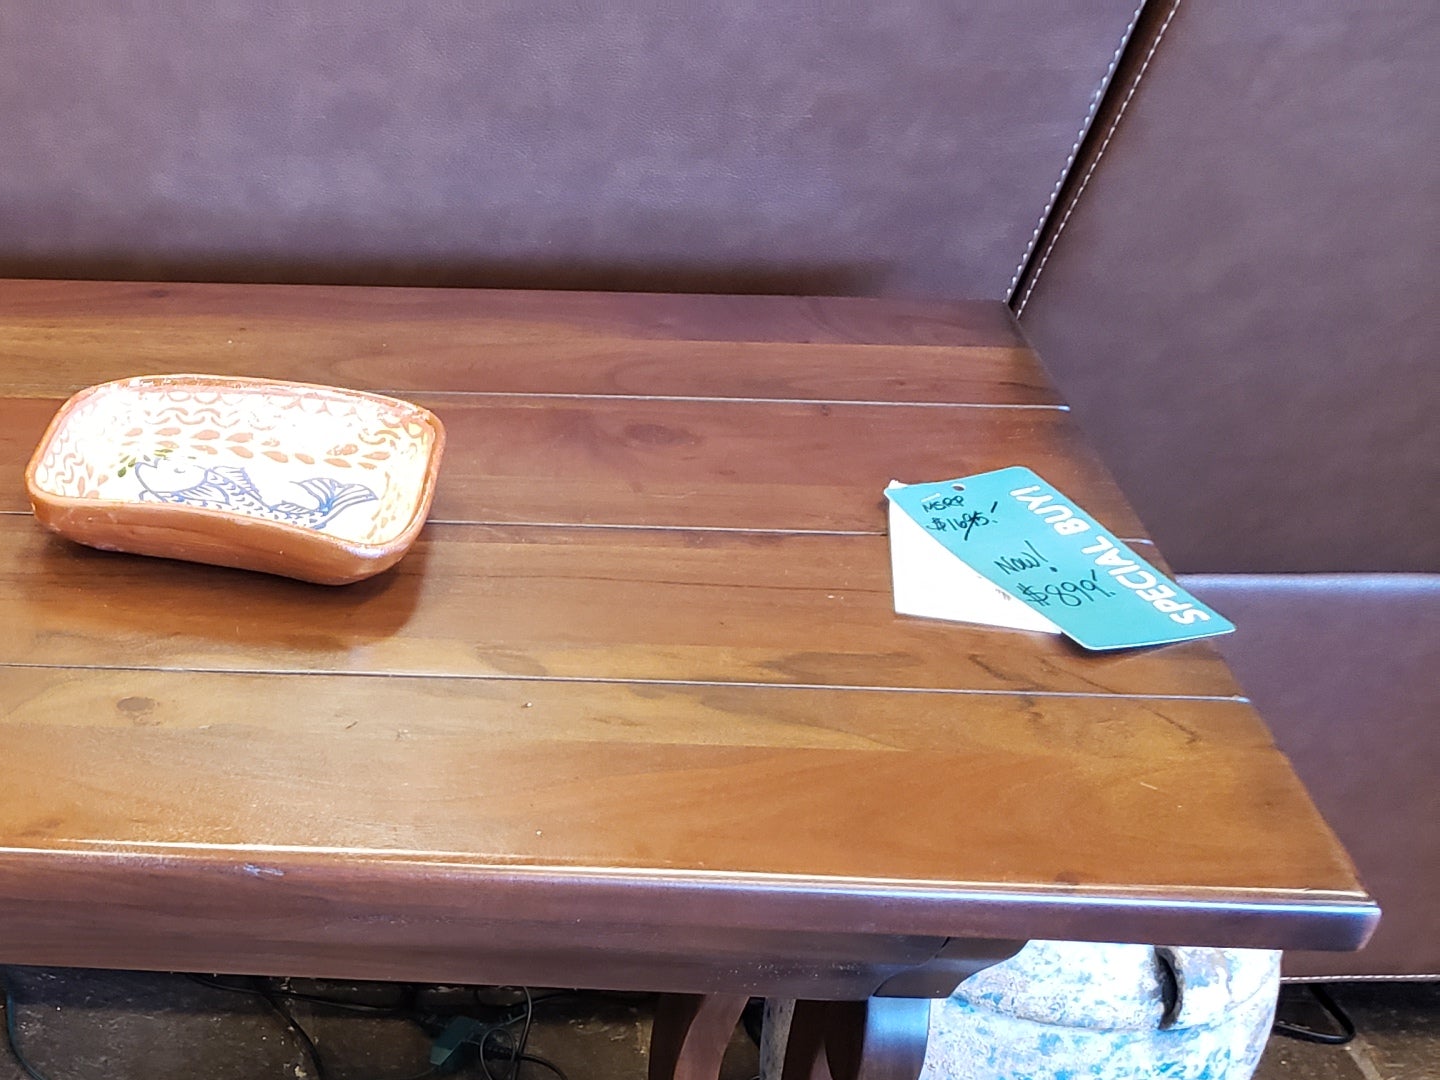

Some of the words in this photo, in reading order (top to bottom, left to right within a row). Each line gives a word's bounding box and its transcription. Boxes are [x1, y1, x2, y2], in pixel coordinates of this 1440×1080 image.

[922, 495, 964, 513] MSRP
[1009, 485, 1091, 536] BUY!
[1083, 535, 1212, 625] SPECIAL
